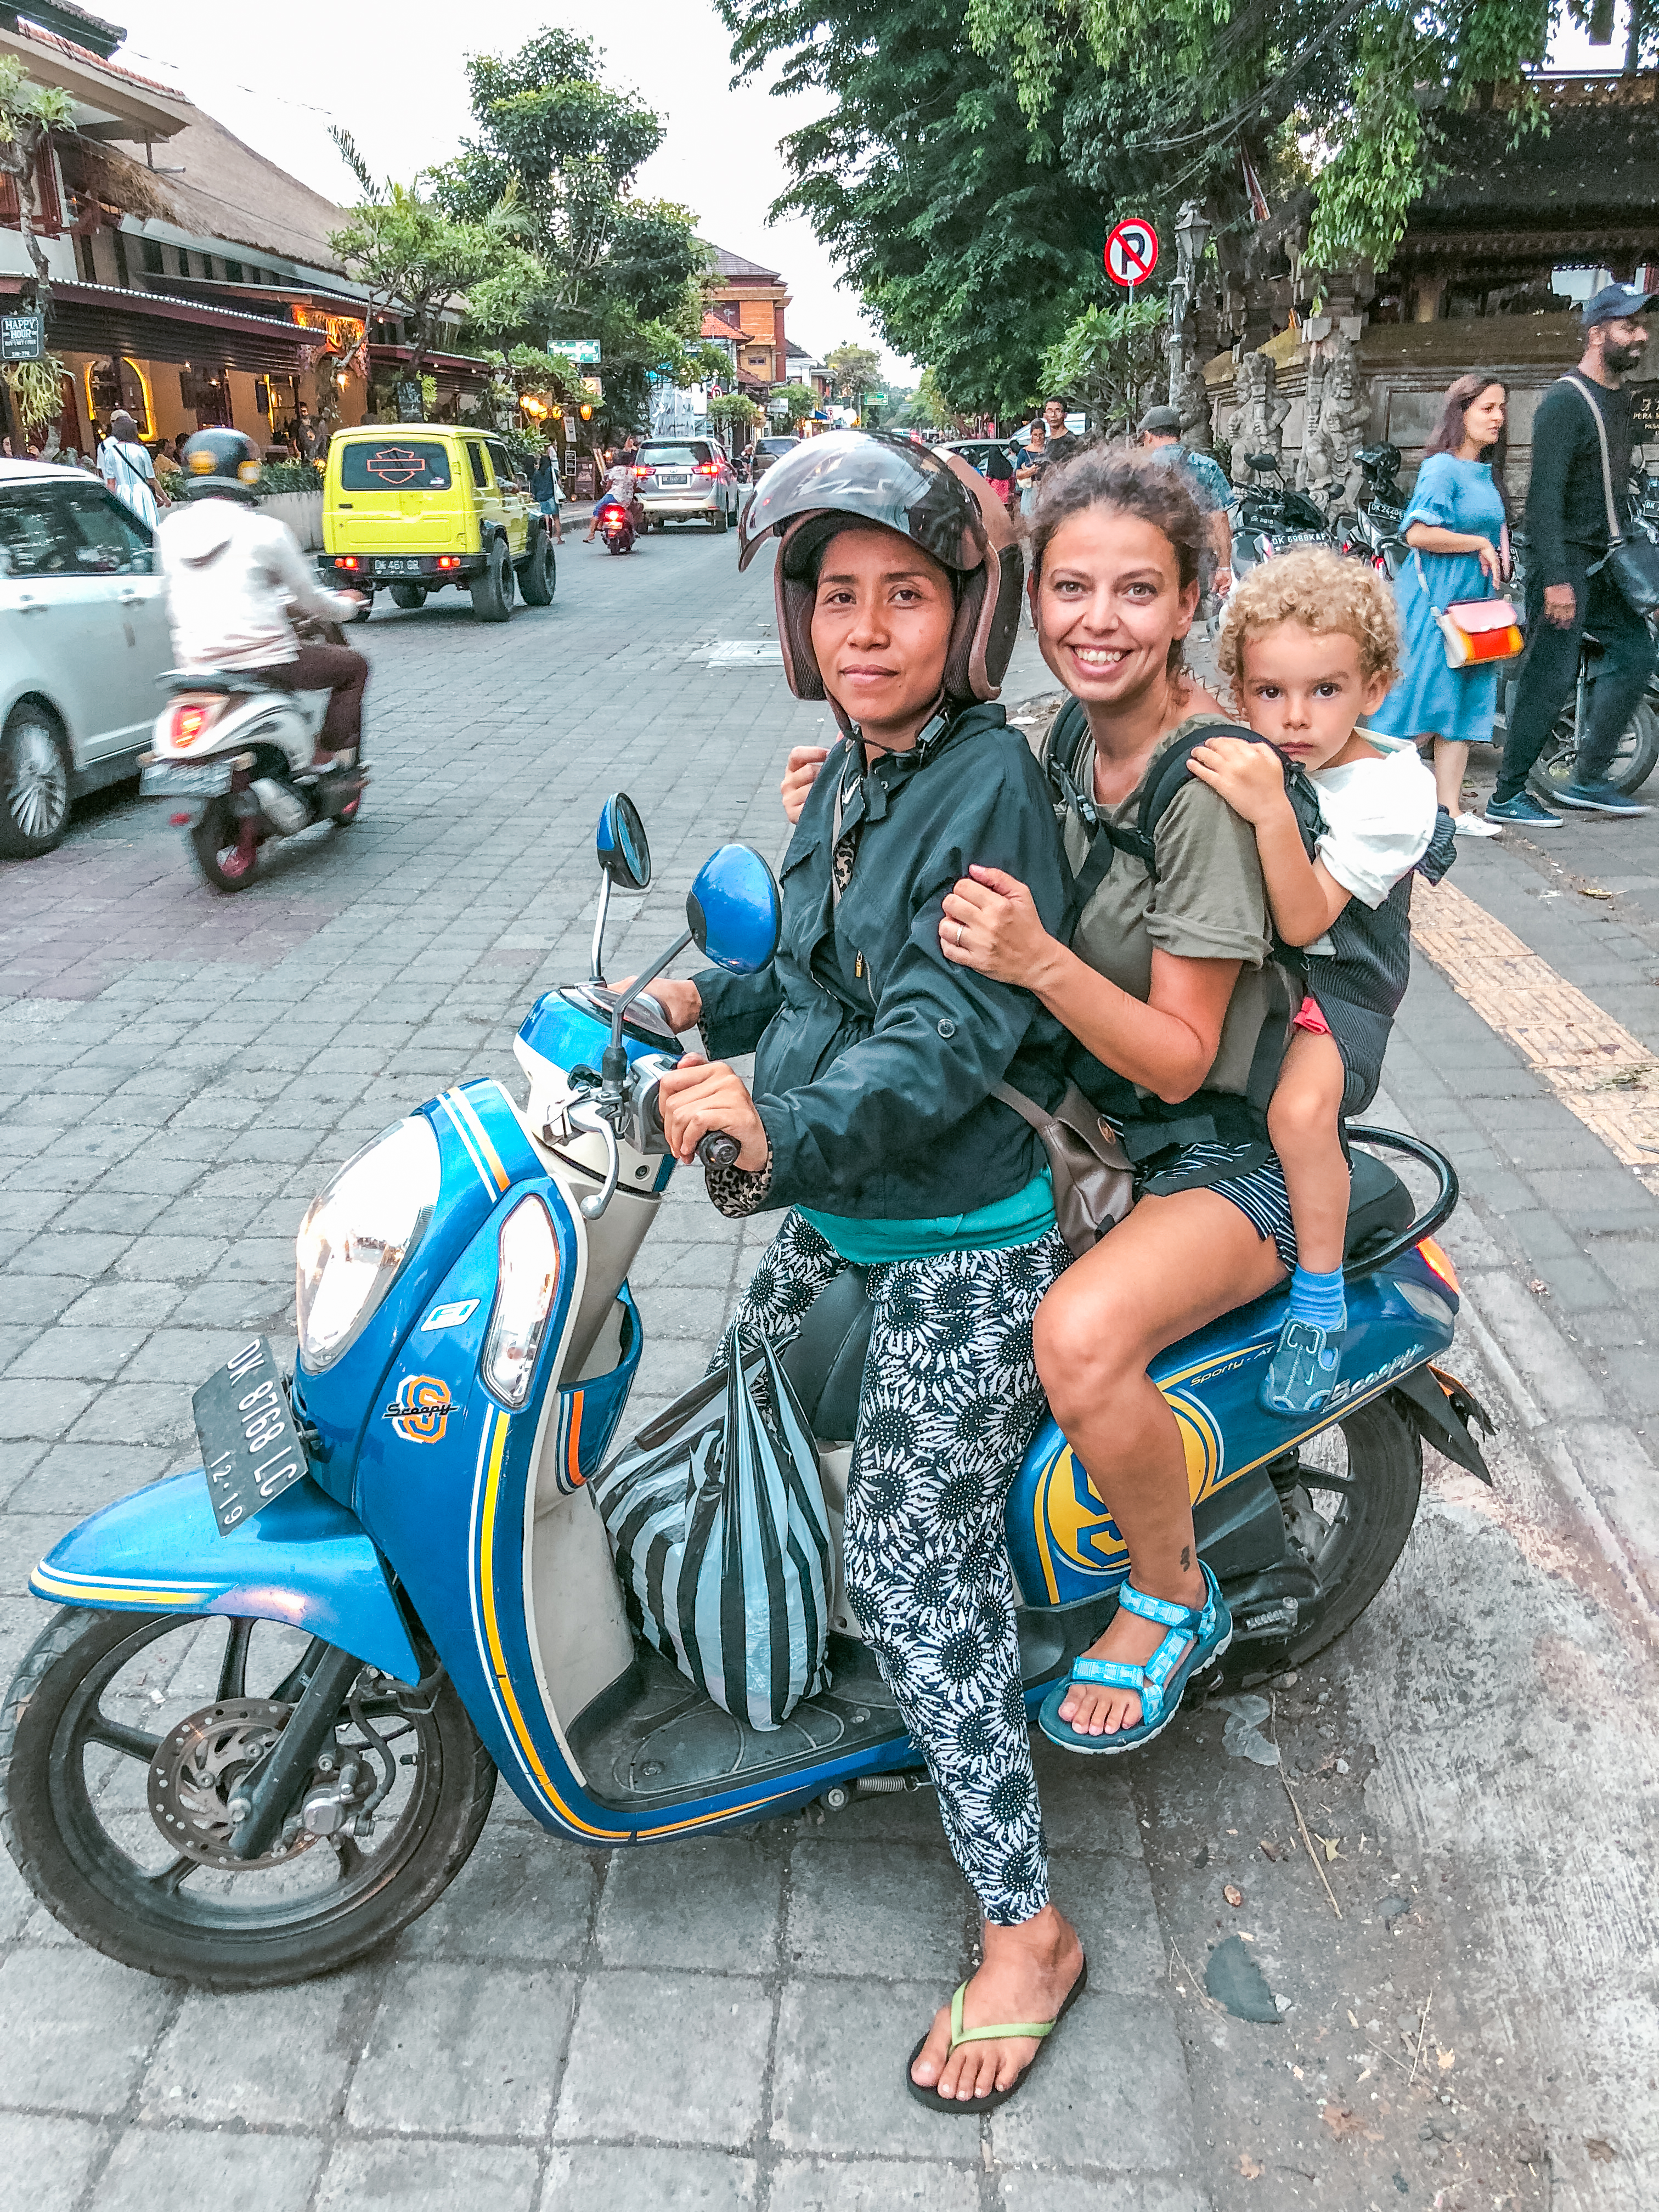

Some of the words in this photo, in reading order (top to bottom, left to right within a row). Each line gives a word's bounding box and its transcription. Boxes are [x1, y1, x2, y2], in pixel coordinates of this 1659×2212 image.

[5, 319, 36, 330] HAPPY
[10, 329, 32, 339] HOUR
[1272, 535, 1285, 545] DK
[227, 1338, 265, 1387] DK
[1189, 1358, 1244, 1387] Sporty
[1254, 1345, 1276, 1359] AT
[238, 1380, 285, 1454] 8768
[382, 1402, 460, 1418] Scoopy
[253, 1446, 297, 1497] LC
